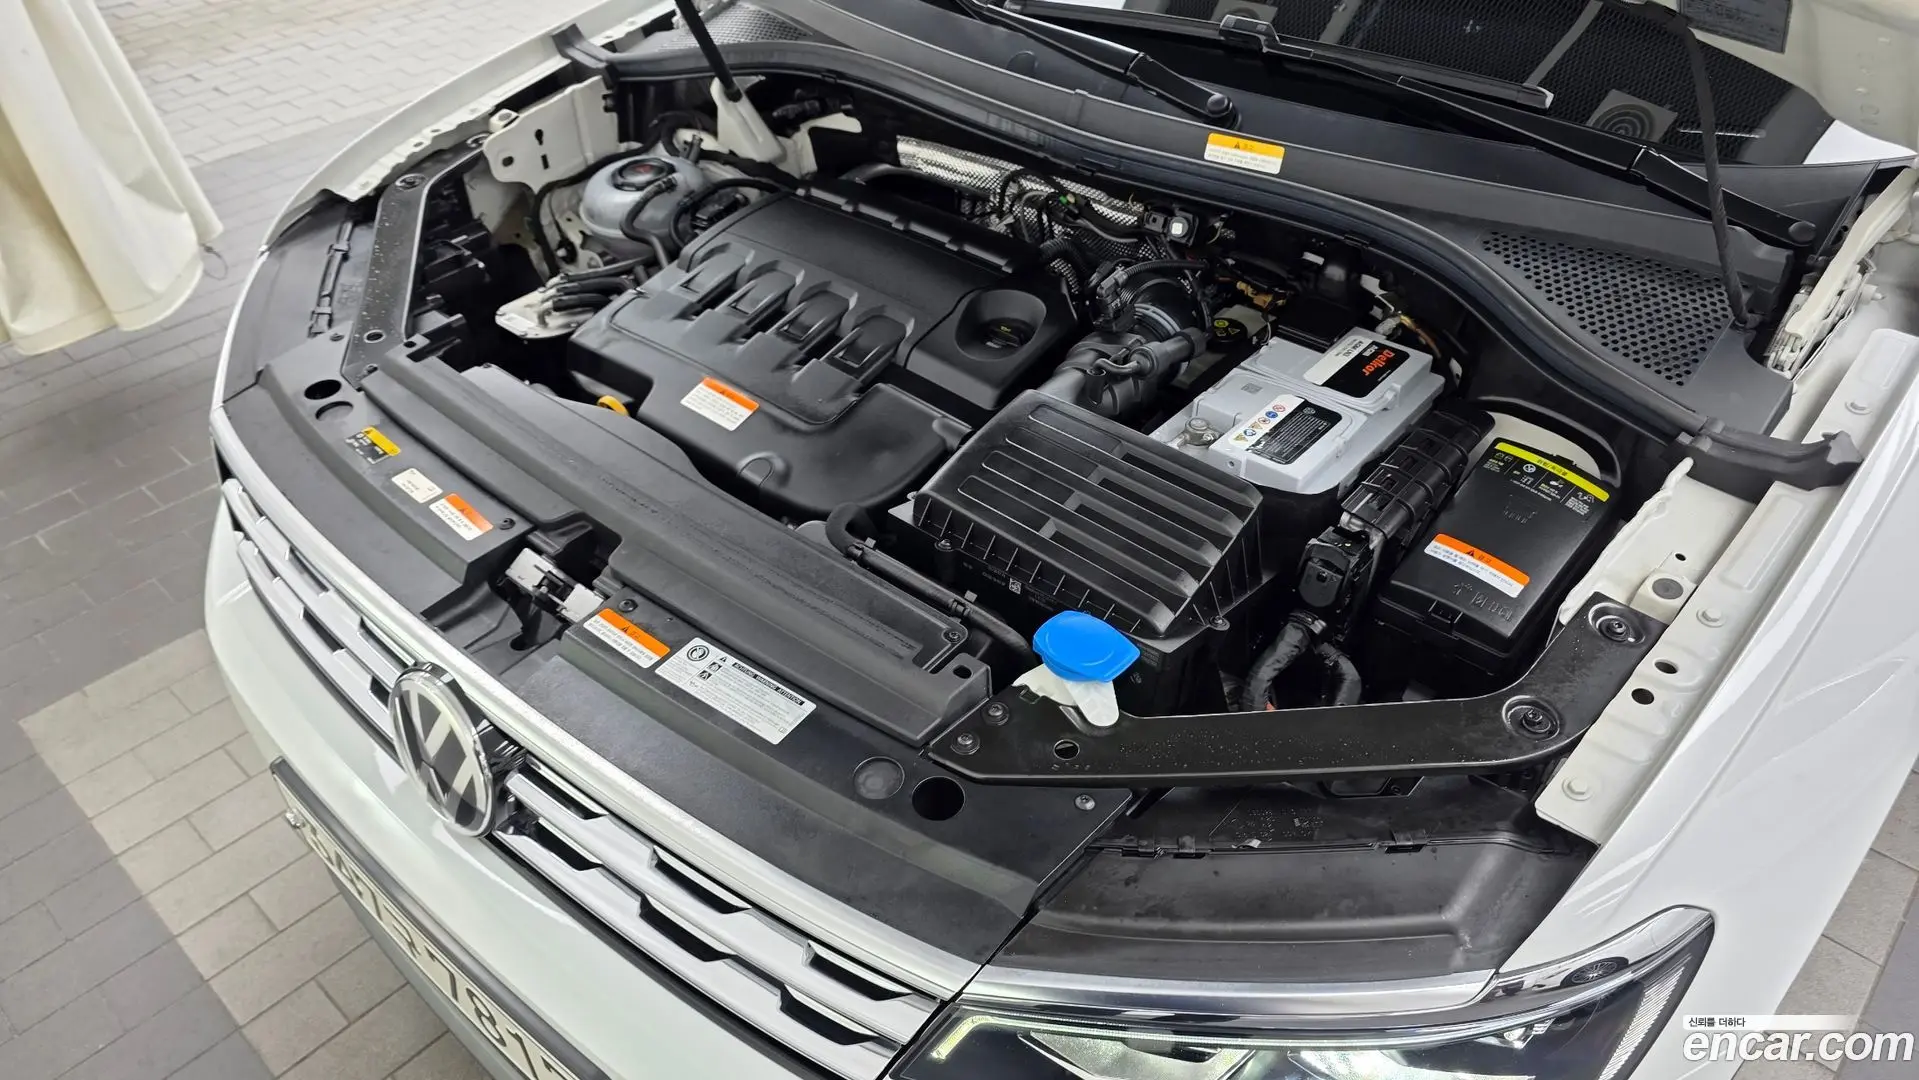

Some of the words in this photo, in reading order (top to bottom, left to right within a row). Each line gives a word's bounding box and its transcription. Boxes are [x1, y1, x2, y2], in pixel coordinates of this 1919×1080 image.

[1361, 348, 1395, 376] Delkor
[755, 674, 778, 691] WARNING
[777, 687, 803, 706] ATTENTION
